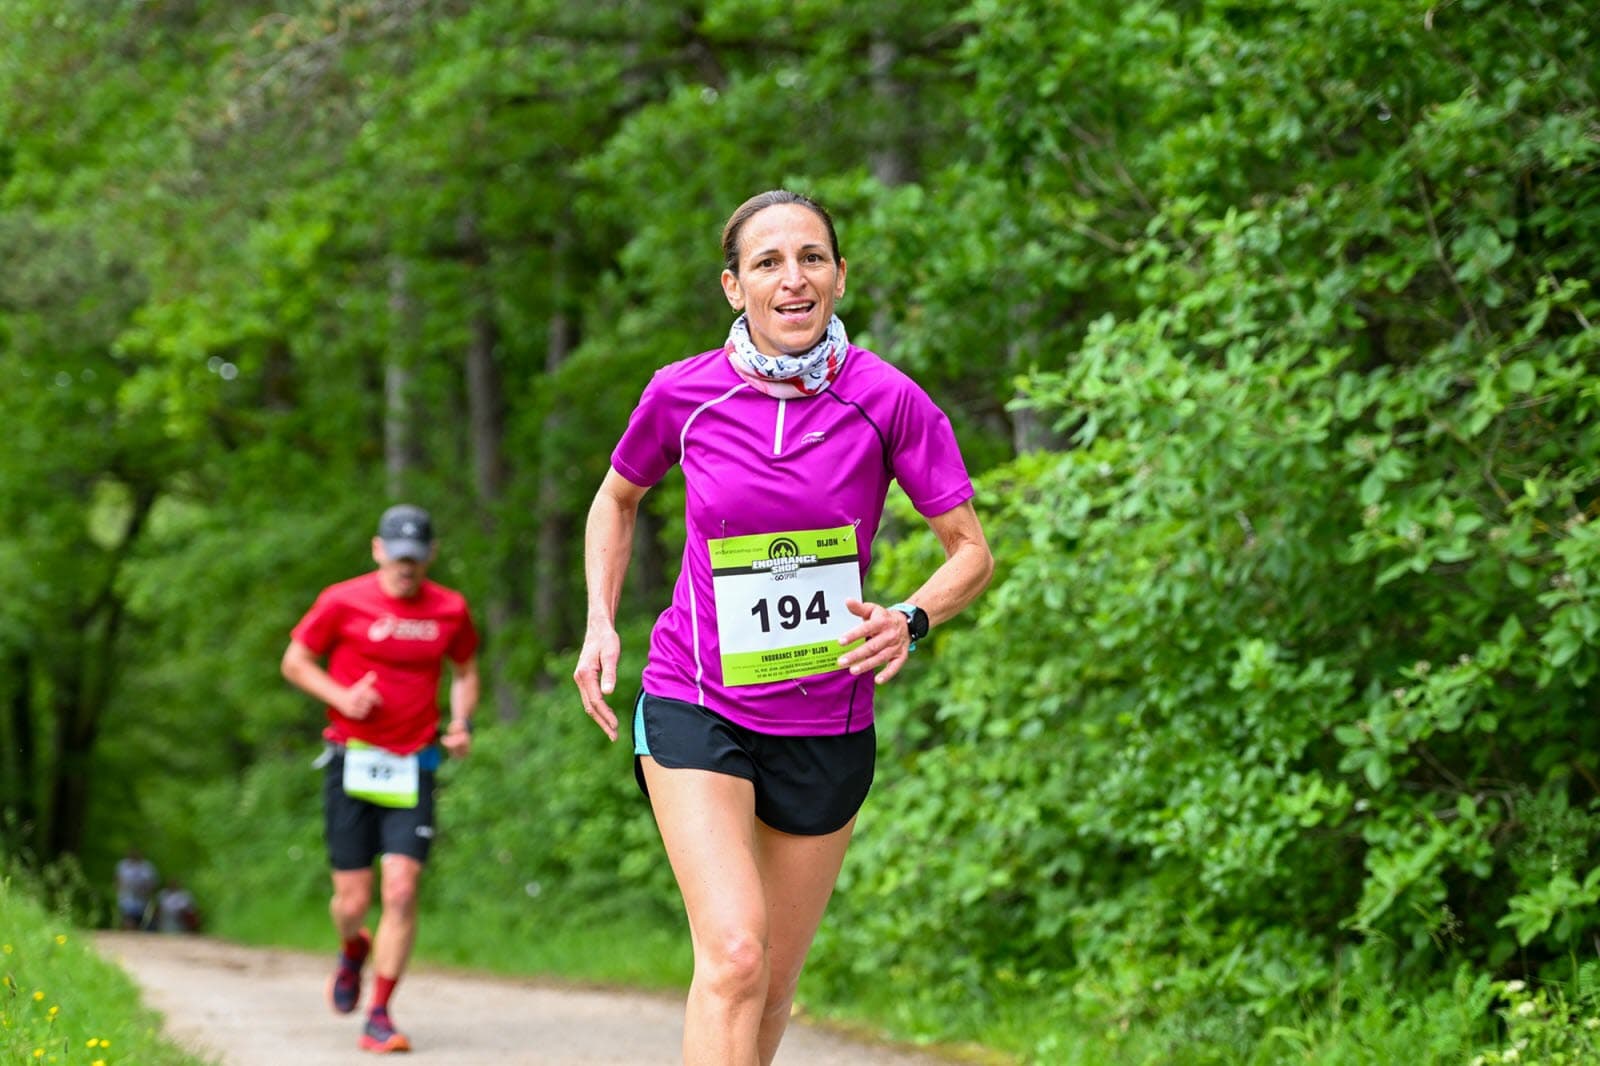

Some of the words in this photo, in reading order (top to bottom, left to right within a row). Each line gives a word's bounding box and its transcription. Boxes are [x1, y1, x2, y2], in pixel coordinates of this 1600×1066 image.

[816, 538, 839, 548] DIJON
[752, 554, 818, 570] ENDURANCE
[771, 564, 799, 574] SHOP
[751, 590, 830, 633] 194
[761, 651, 792, 663] ENDURANCE
[793, 648, 808, 658] SHOP
[812, 646, 829, 655] DIJON
